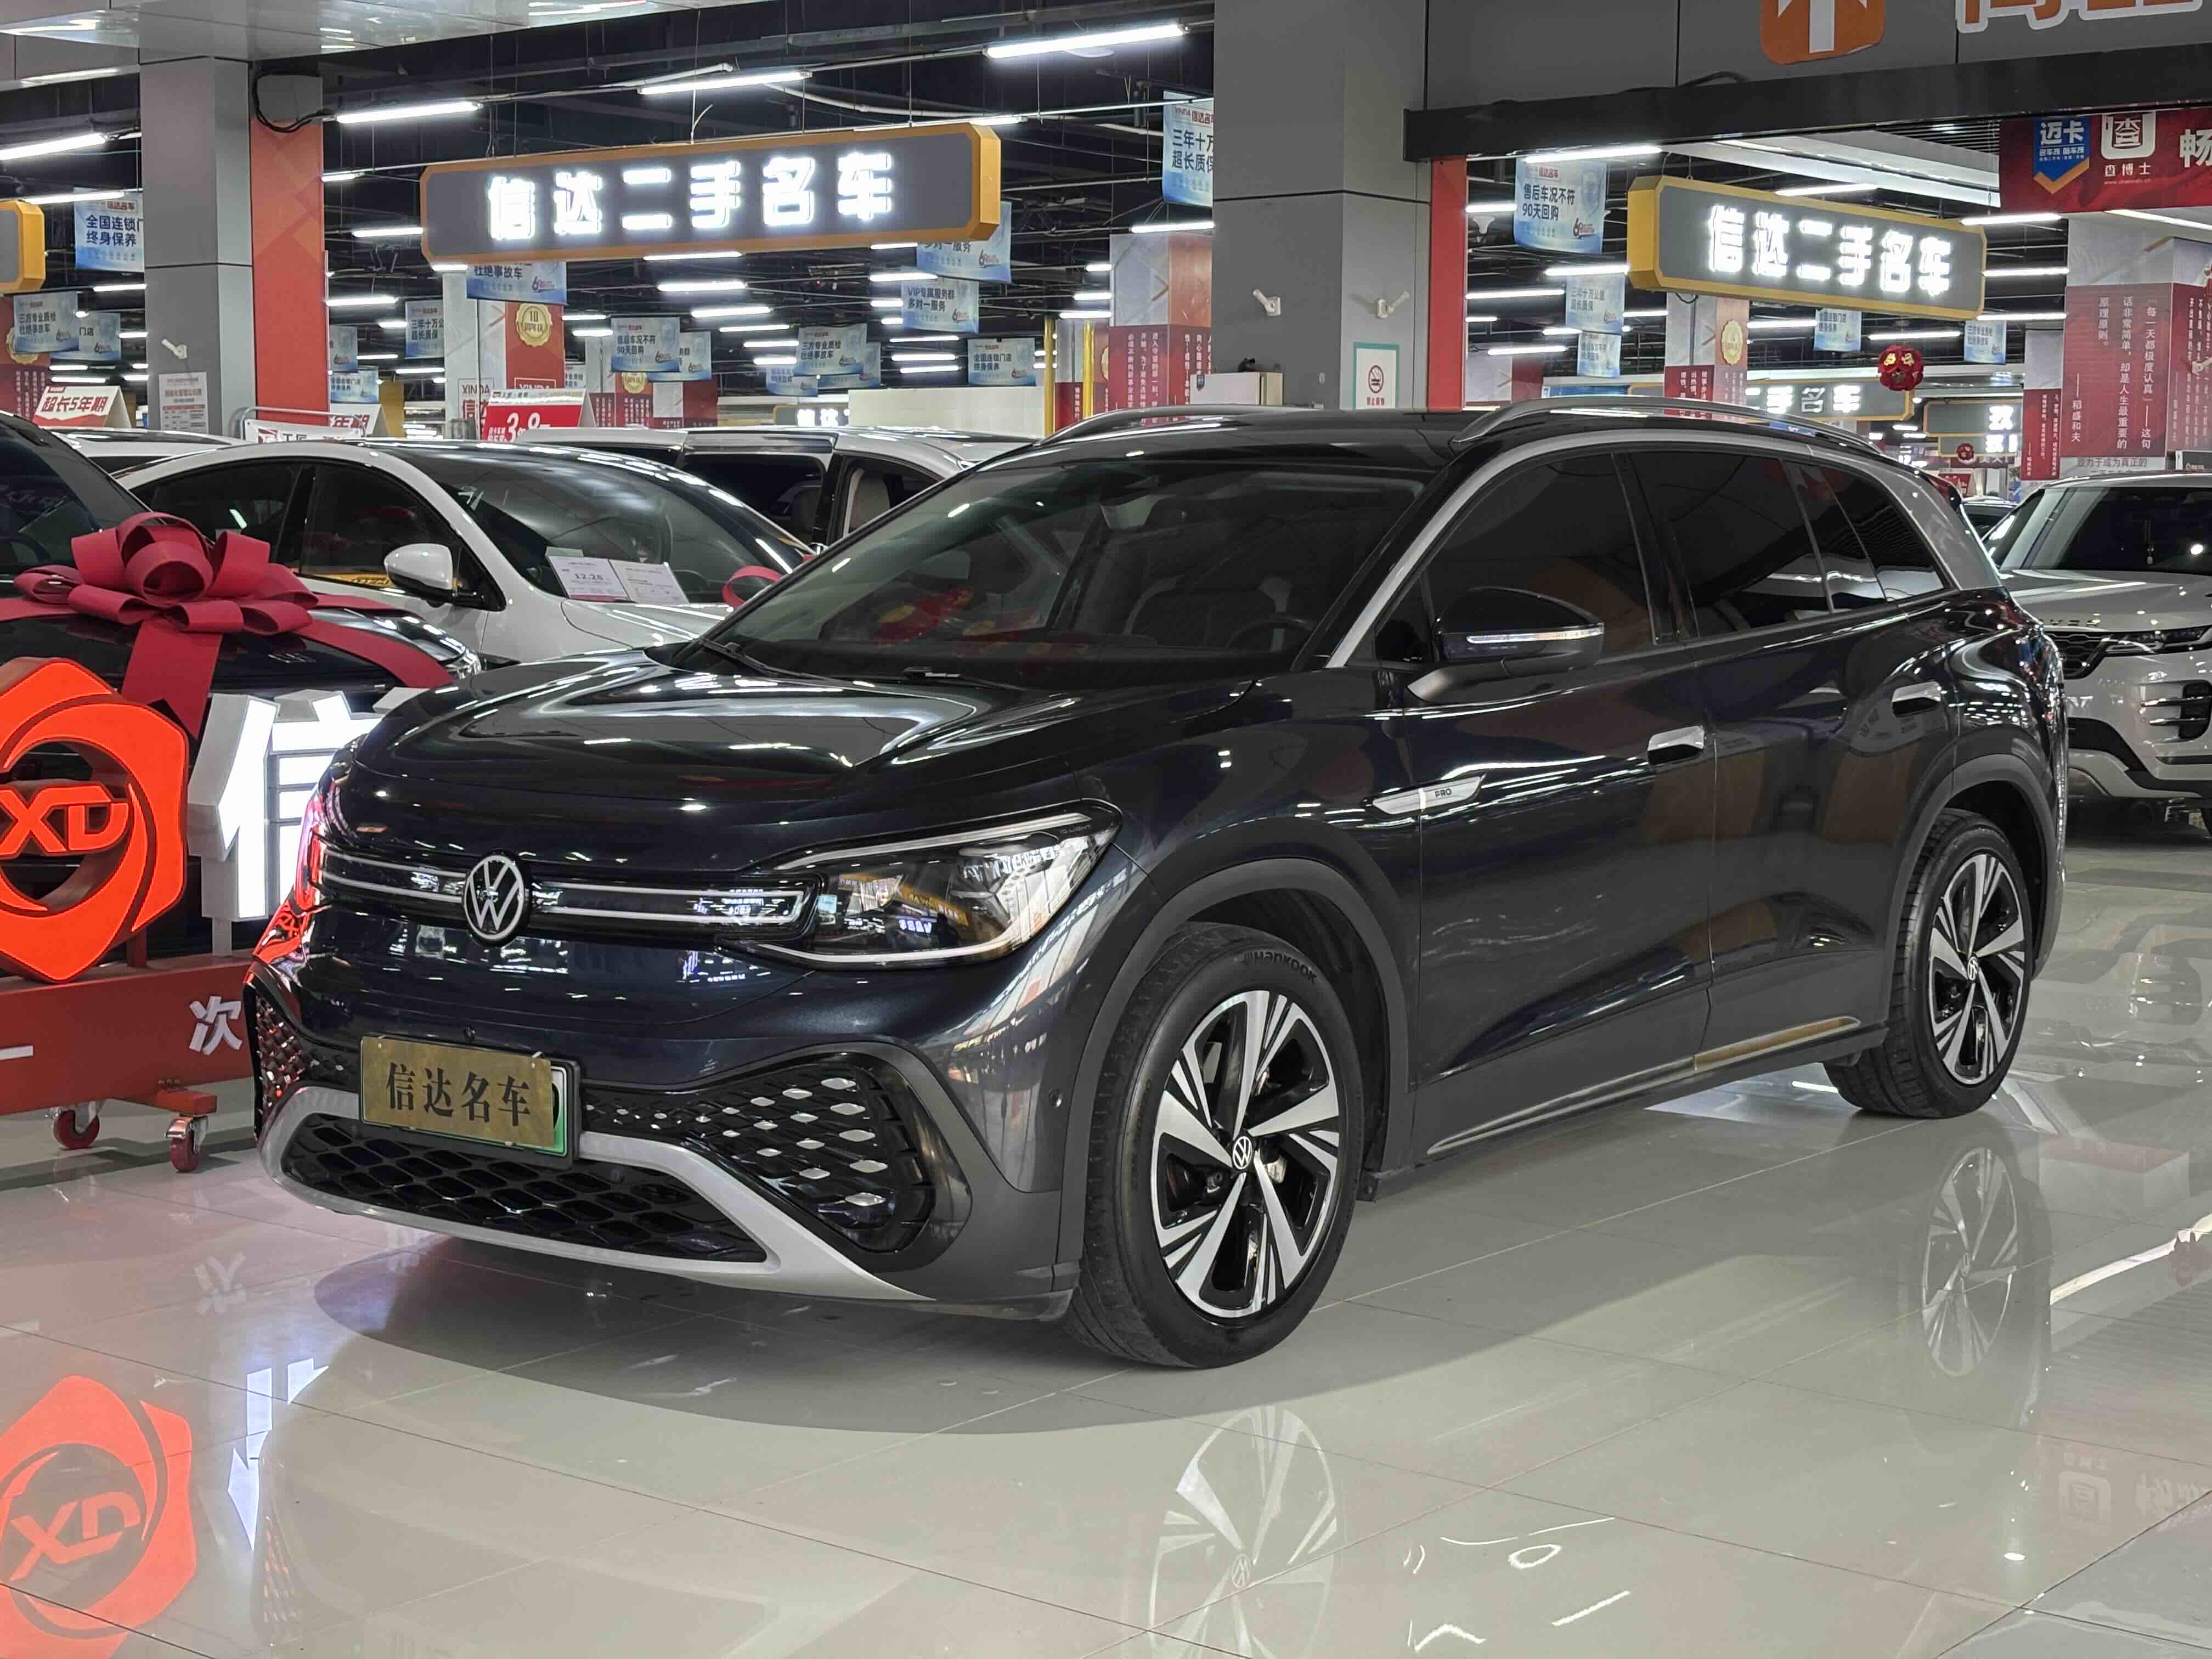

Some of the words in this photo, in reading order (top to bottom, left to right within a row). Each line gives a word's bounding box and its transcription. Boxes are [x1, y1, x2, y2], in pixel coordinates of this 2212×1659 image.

[2040, 120, 2085, 145] 迈卡
[488, 152, 893, 240] 信达二手名车
[1523, 183, 1576, 205] 售后车况不符
[1522, 202, 1559, 222] 90天回购
[86, 230, 137, 247] 终身保养
[1708, 204, 1951, 297] 信达二手名车
[461, 384, 490, 396] XINDA
[189, 996, 243, 1055] 次
[386, 1062, 531, 1126] 信达名车
